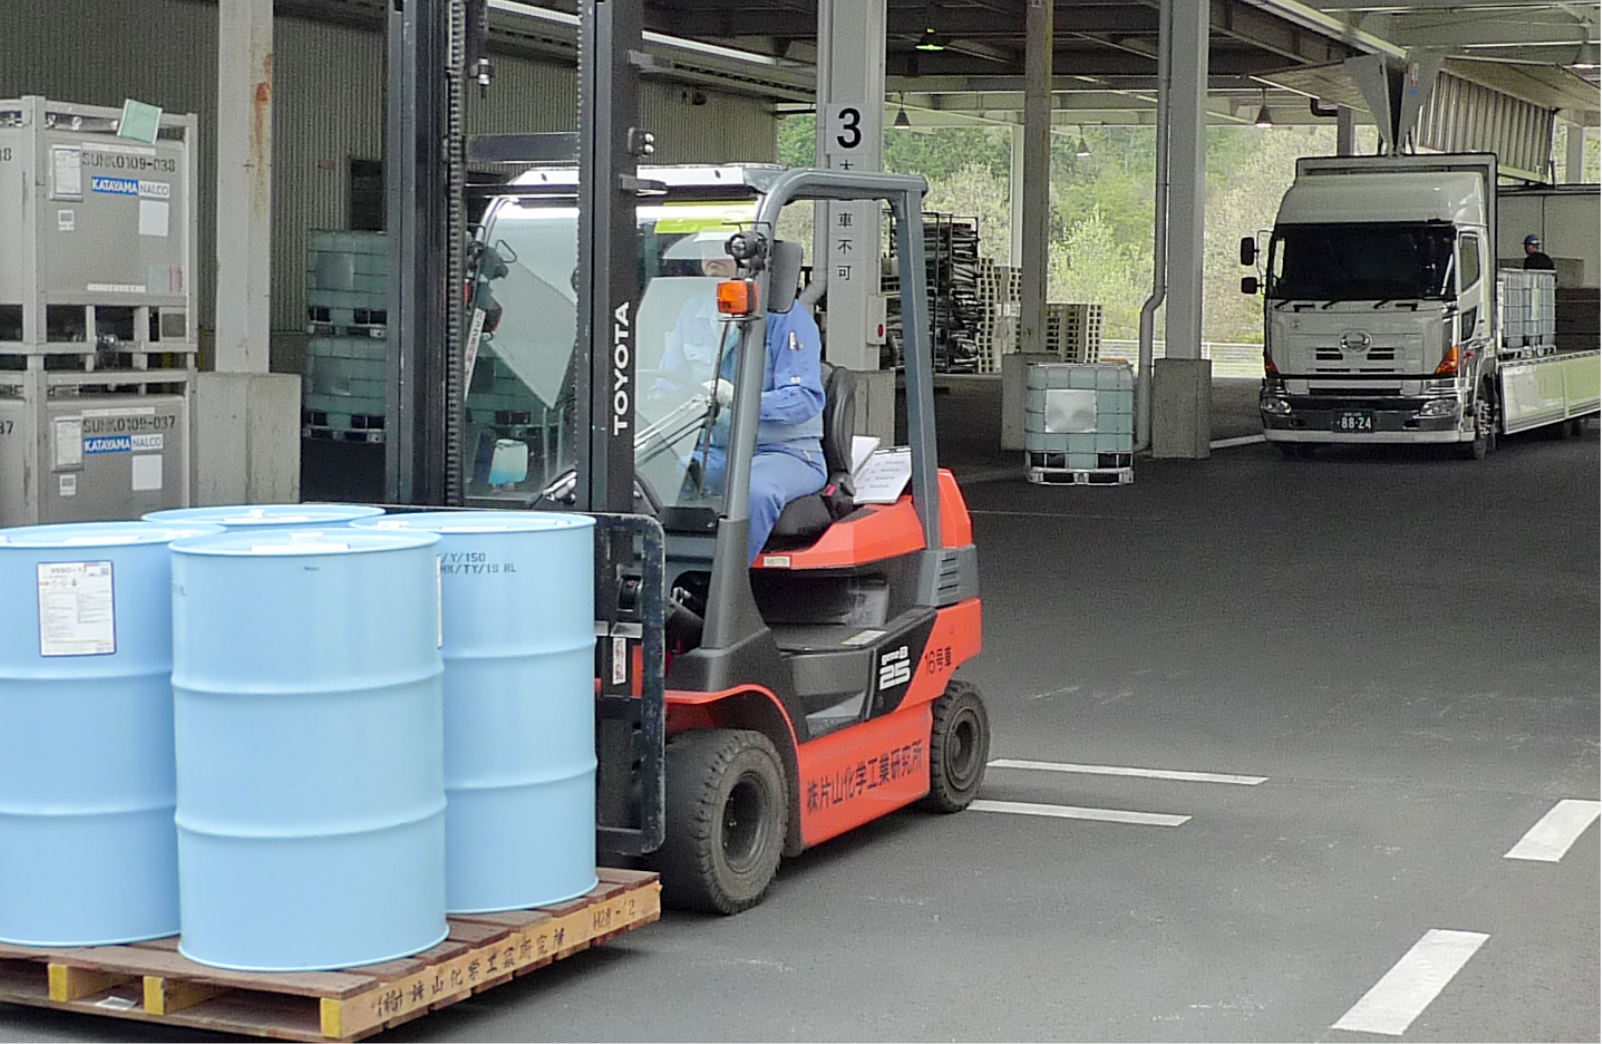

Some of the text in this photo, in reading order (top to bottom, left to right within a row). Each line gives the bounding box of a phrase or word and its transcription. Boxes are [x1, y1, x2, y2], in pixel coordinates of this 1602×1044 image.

[837, 107, 861, 148] 3
[92, 178, 169, 196] KATAYAMA NALCO
[837, 159, 853, 281] 大車不可
[613, 301, 629, 436] TOYOTA
[84, 437, 162, 452] KATAYAMA NALCO
[879, 659, 911, 690] 25
